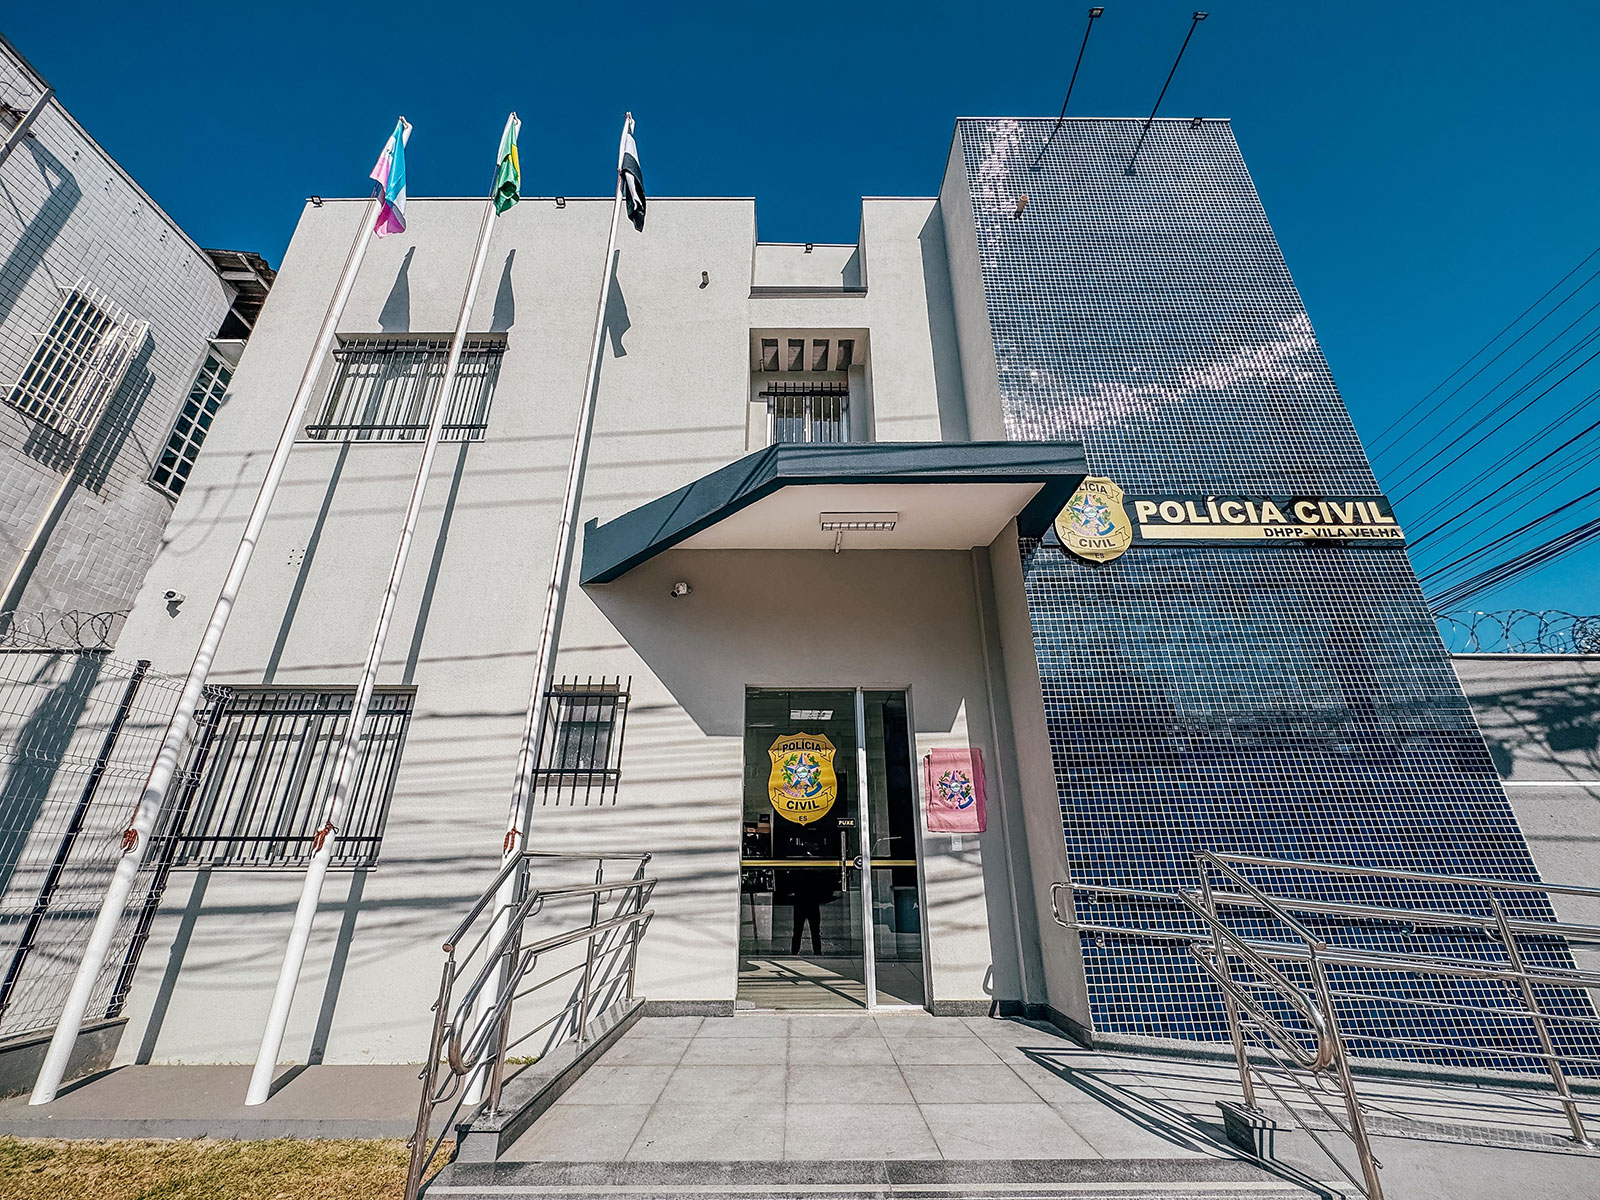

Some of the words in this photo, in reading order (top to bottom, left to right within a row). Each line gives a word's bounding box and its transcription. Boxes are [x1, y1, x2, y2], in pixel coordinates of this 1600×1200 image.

[1134, 496, 1286, 523] POLÍCIA
[1294, 500, 1395, 524] CIVIL
[1311, 527, 1348, 538] VILA
[1346, 527, 1401, 538] VELHA
[1078, 538, 1116, 548] CIVIL
[782, 739, 822, 752] POLÍCIA
[786, 800, 820, 810] CIVIL
